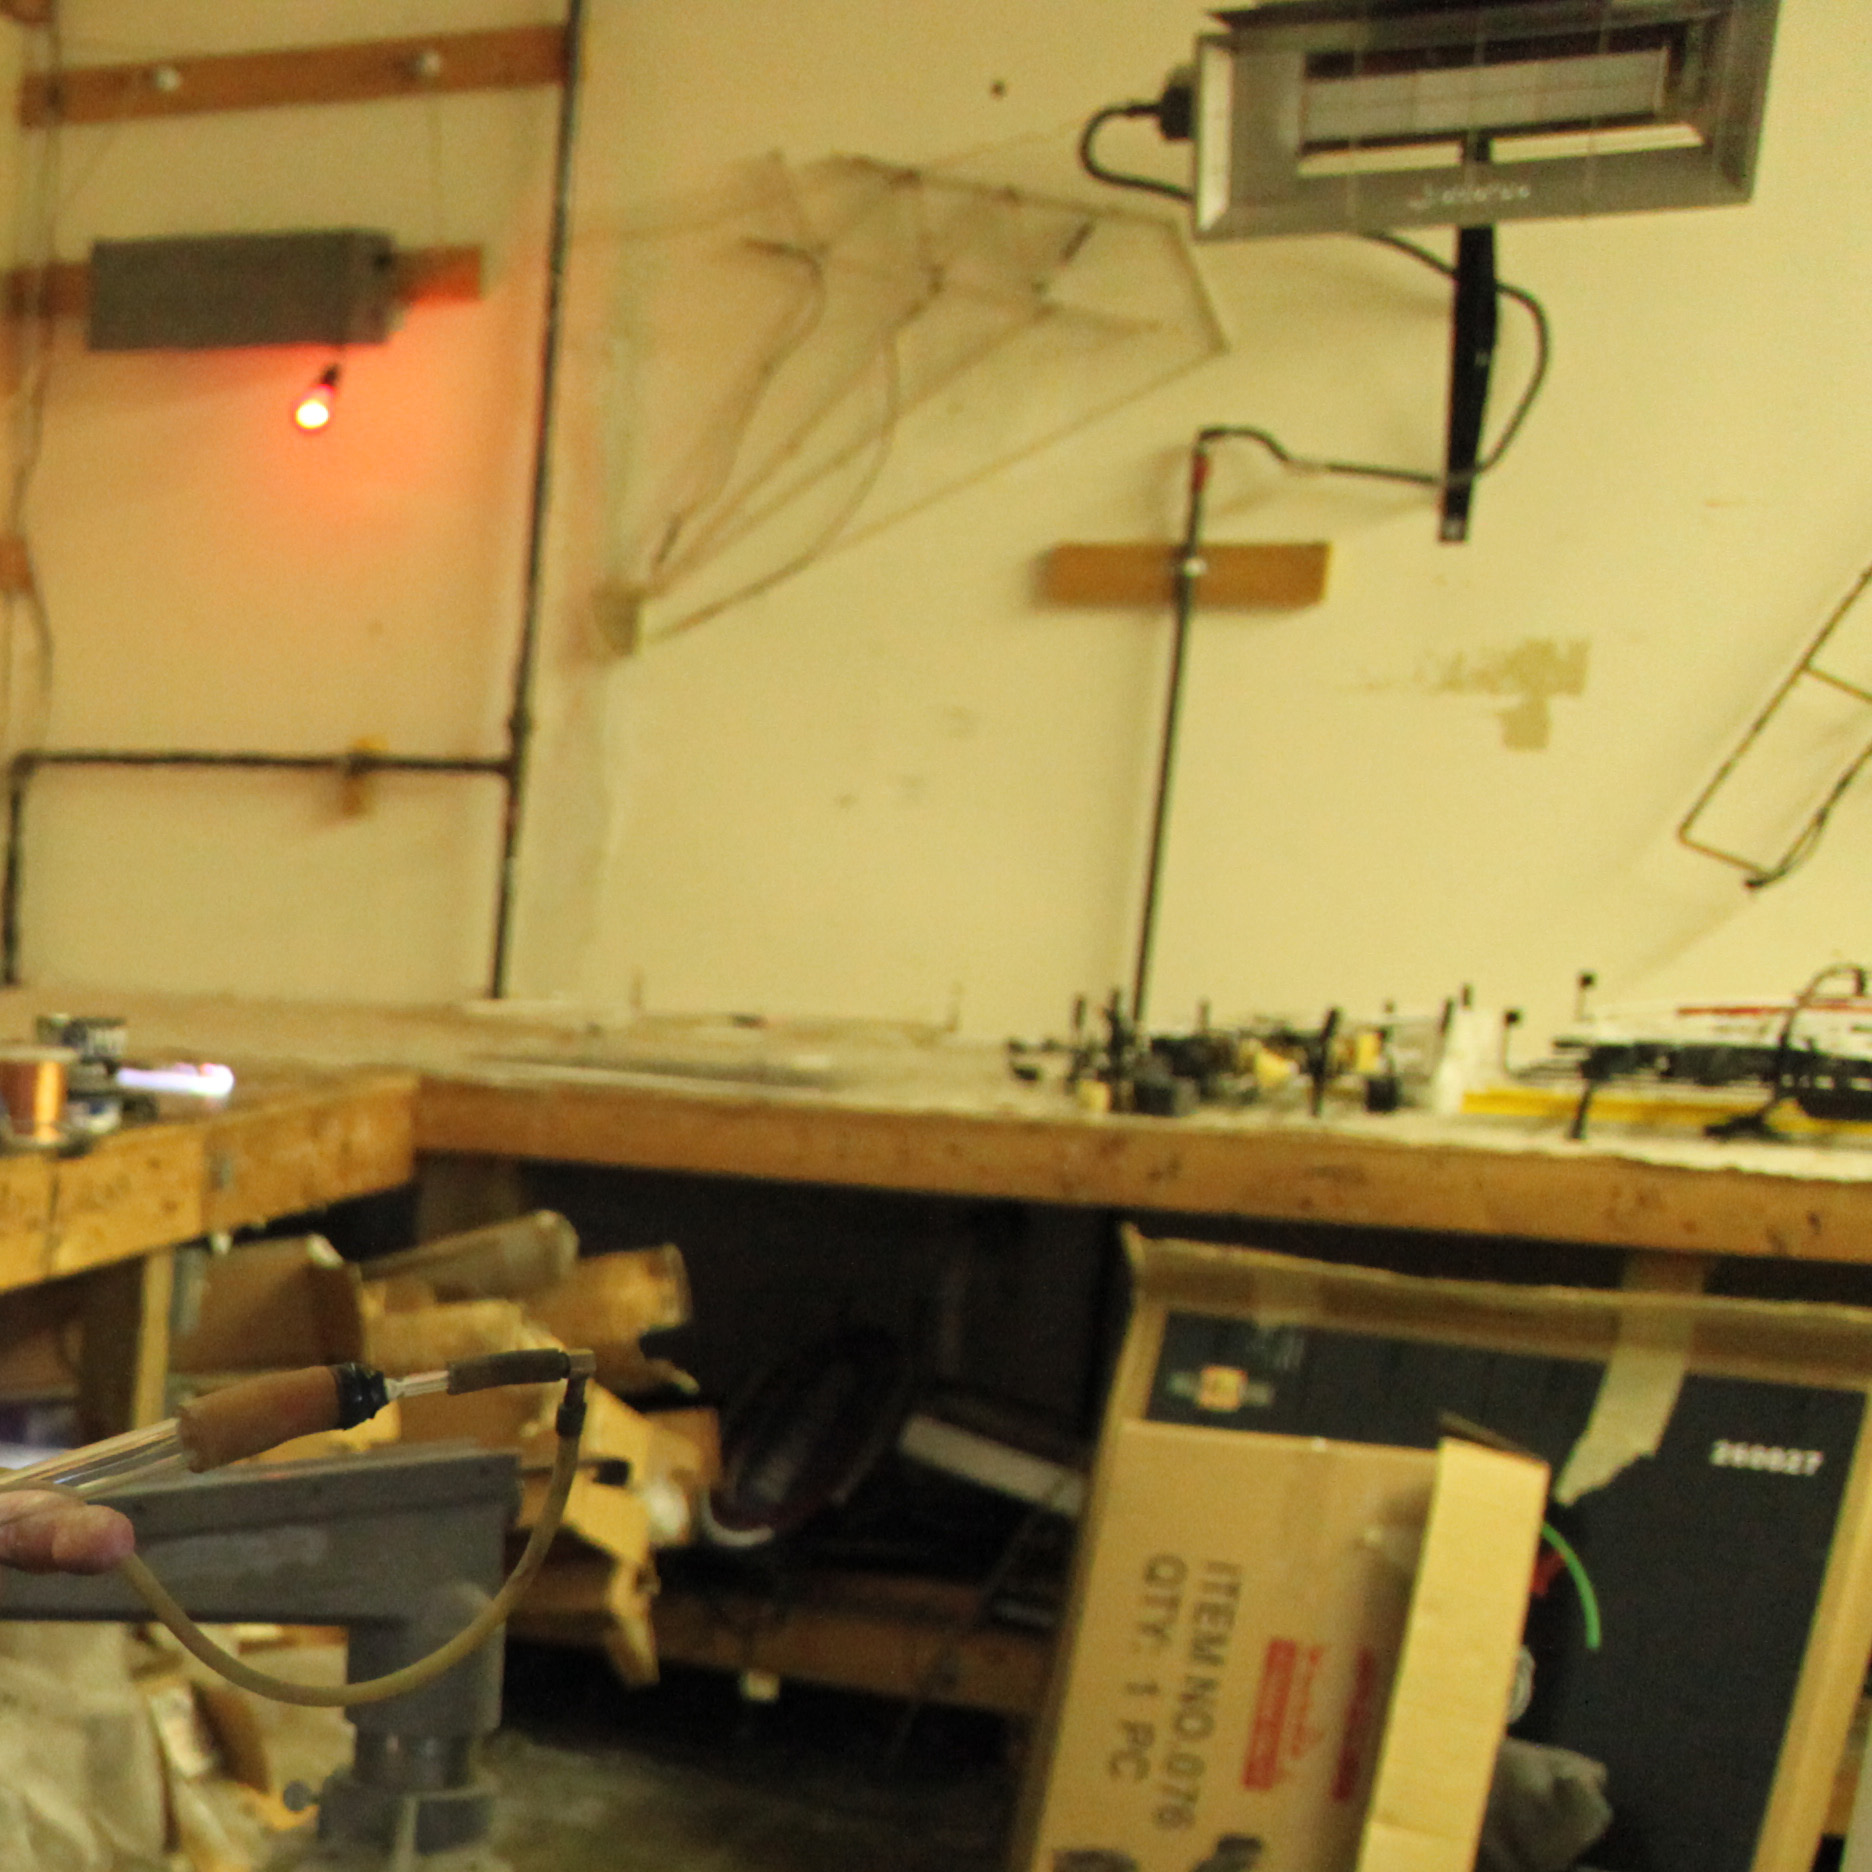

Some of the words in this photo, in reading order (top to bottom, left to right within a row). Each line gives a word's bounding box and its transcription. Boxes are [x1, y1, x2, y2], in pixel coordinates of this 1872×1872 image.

[1190, 1560, 1242, 1667] ITEM
[1123, 1680, 1160, 1696] 1
[1107, 1719, 1156, 1782] PC
